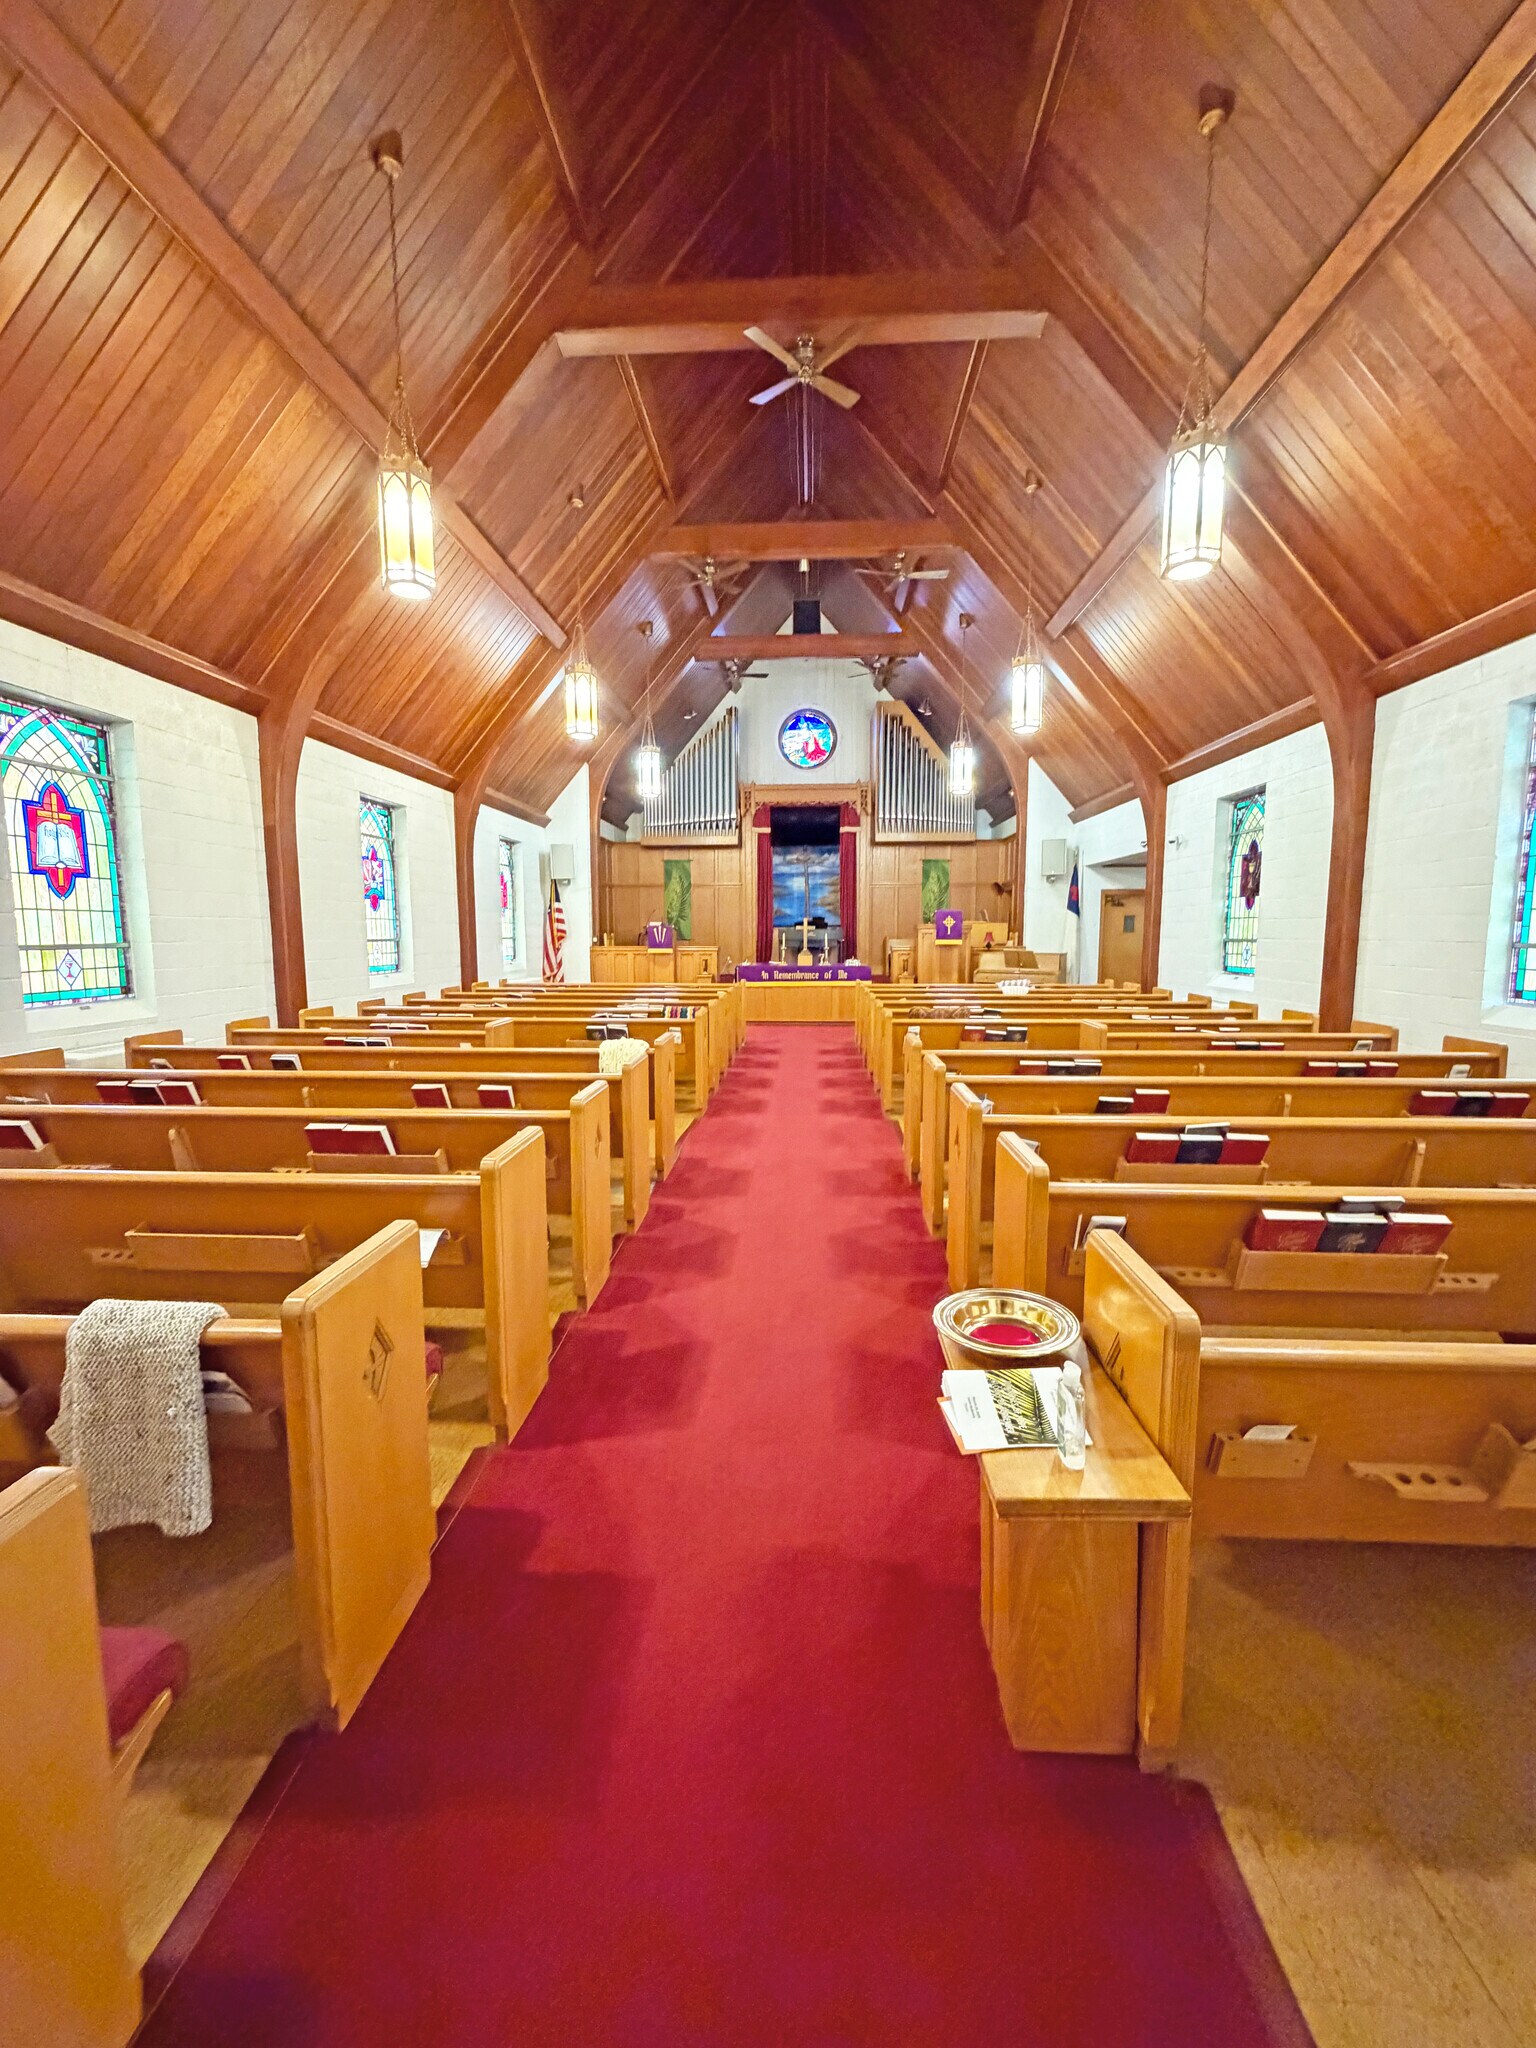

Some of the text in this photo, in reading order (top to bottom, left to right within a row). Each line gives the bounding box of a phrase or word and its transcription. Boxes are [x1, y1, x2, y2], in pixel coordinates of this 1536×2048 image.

[761, 970, 848, 980] In Remembrance of Me
